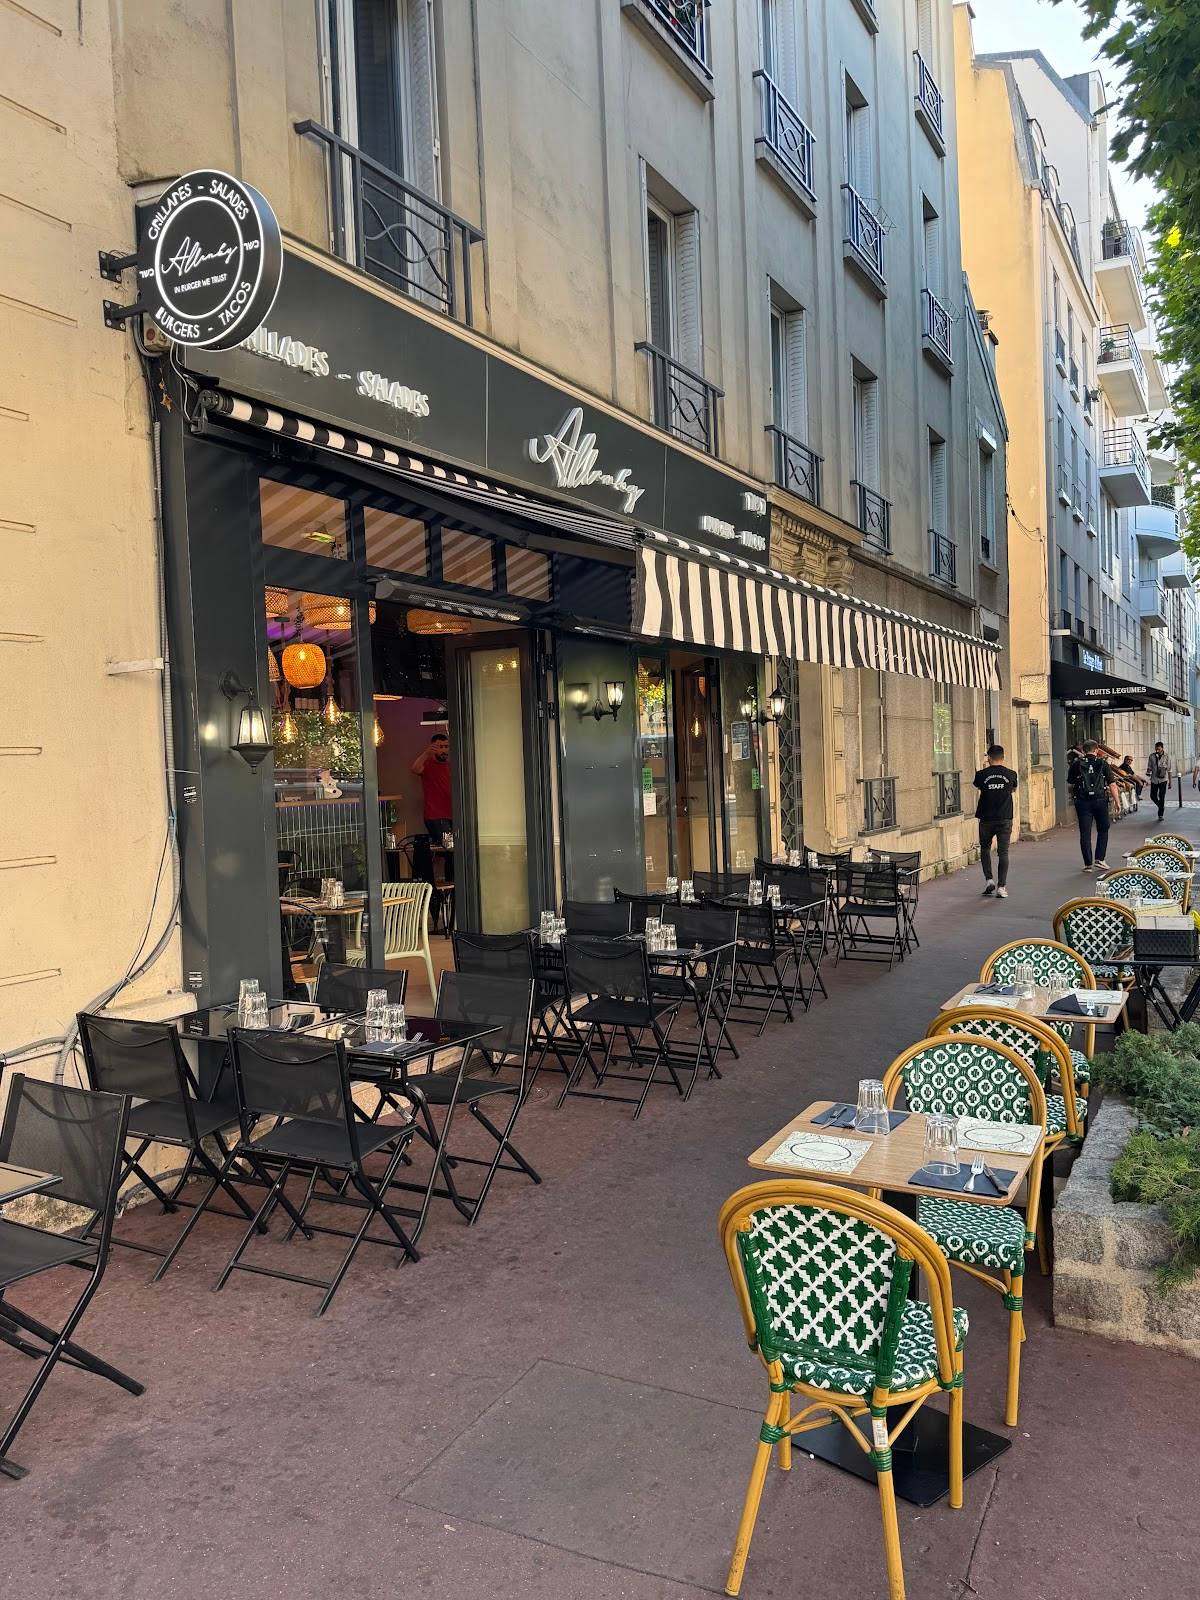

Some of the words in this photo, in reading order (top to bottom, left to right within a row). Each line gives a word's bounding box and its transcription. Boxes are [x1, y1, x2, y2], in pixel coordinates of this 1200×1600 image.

[148, 183, 192, 240] GRILLADES
[209, 179, 249, 220] SALADES
[173, 286, 181, 294] IN
[181, 280, 202, 293] BURGER
[202, 278, 211, 287] WE
[211, 273, 228, 284] TRUST
[155, 306, 200, 338] BURGERS
[218, 281, 251, 326] TACOS
[357, 371, 429, 418] SALADES
[1085, 688, 1111, 696] FRUITS
[1112, 686, 1147, 695] LEGUMES
